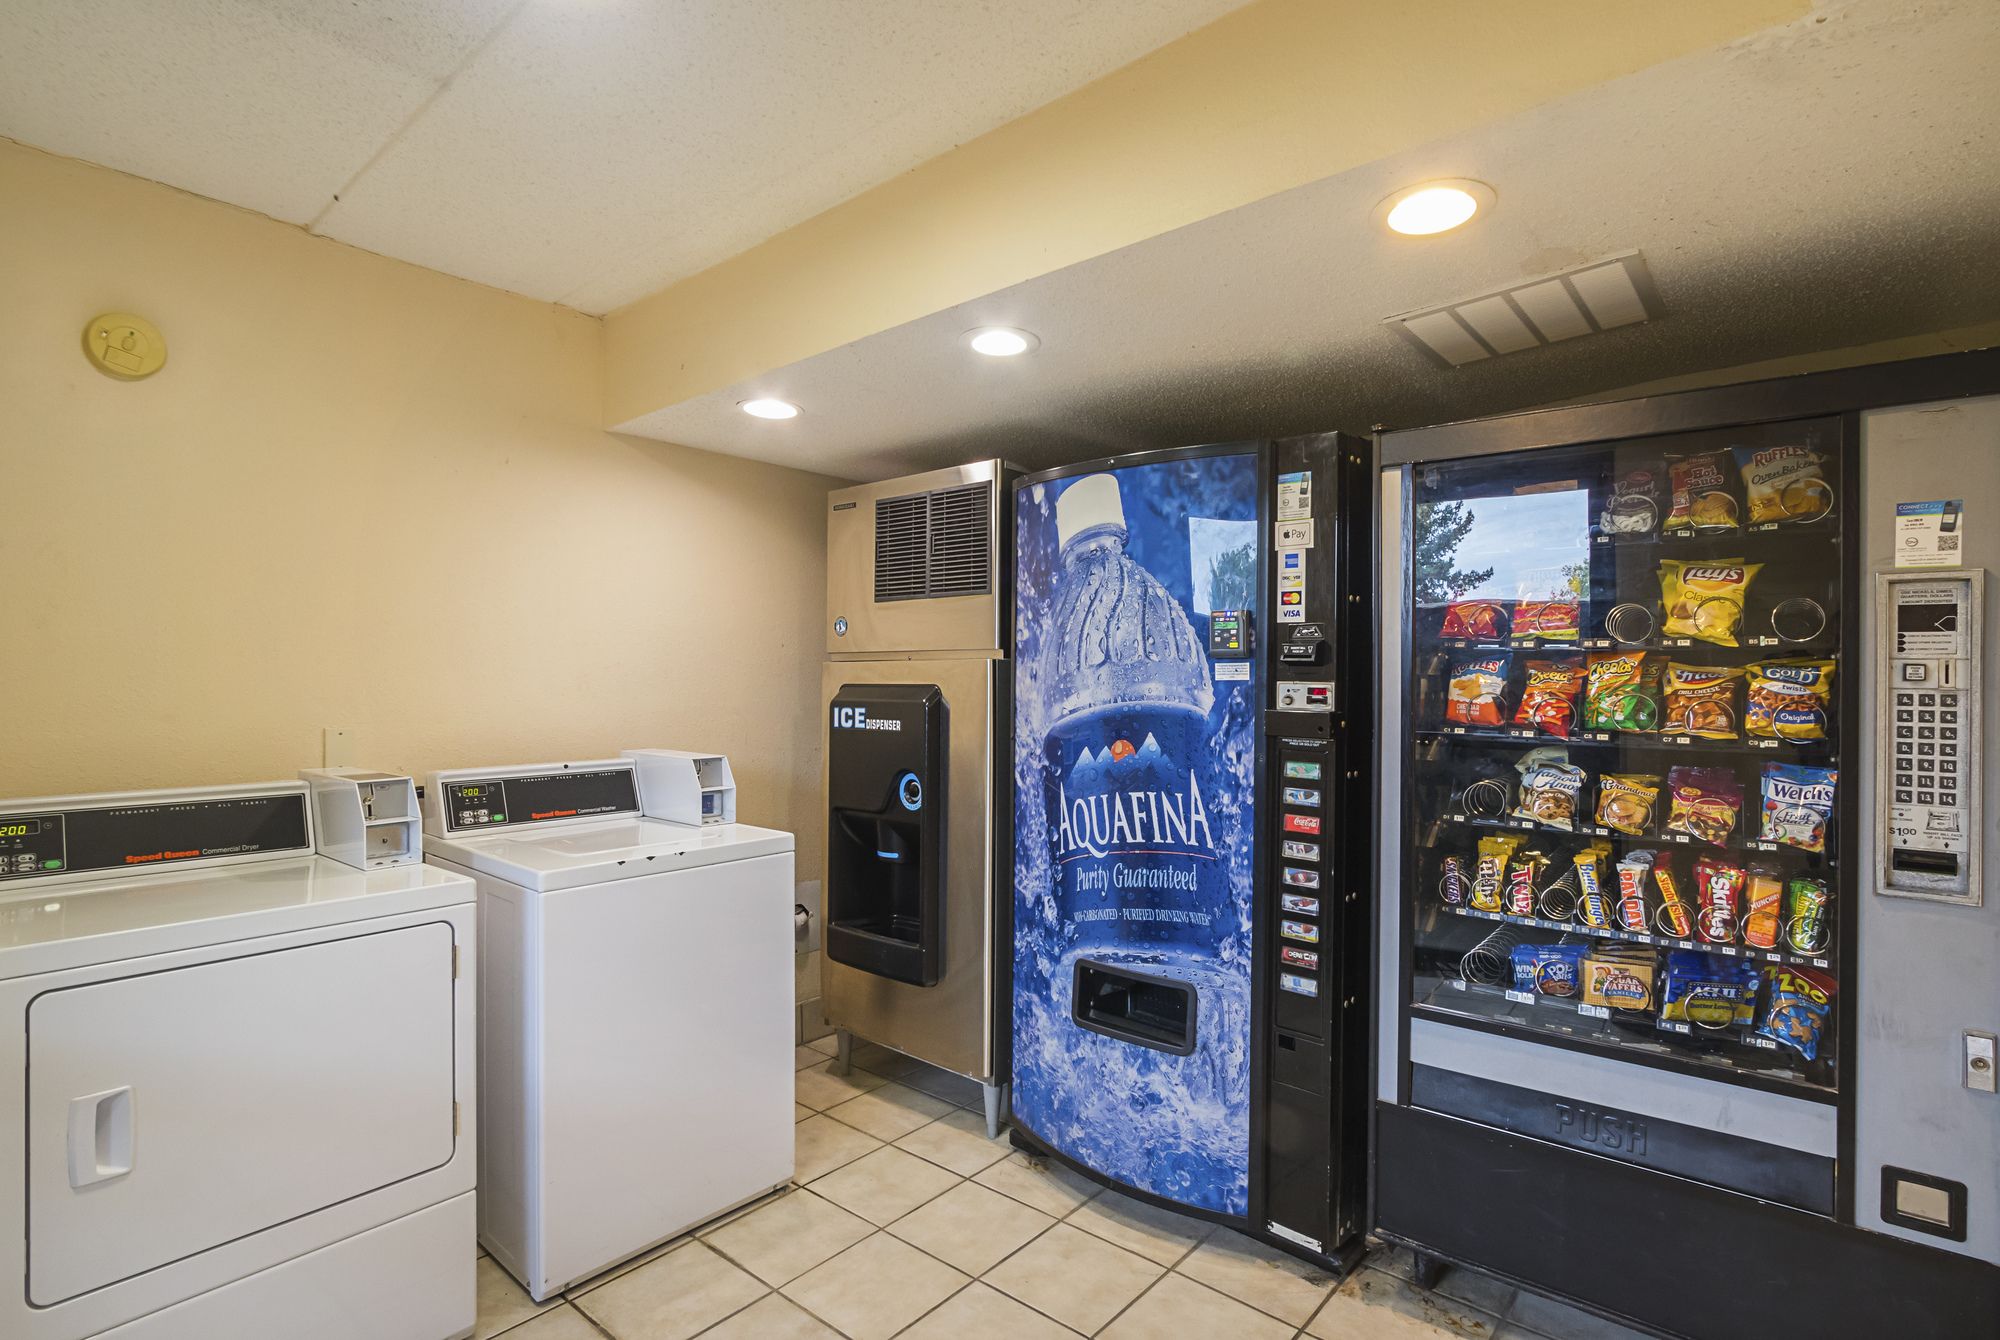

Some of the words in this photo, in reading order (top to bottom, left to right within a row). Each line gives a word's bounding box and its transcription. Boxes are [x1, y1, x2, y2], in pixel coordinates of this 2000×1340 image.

[1754, 446, 1807, 467] RUFFLES
[1291, 529, 1306, 540] Pay
[1284, 610, 1301, 618] VISA
[1588, 656, 1637, 682] Cheetos
[1782, 684, 1807, 692] twists
[834, 707, 866, 729] ICE
[866, 719, 901, 731] DISPENSER
[1536, 779, 1579, 792] Amos
[1773, 783, 1832, 801] Welch's
[578, 806, 601, 814] Commercial
[1060, 768, 1214, 858] AQUAFINA
[126, 852, 162, 863] Speed
[202, 845, 241, 855] Commercial
[242, 843, 259, 851] Dryer
[1077, 864, 1110, 896] Purity
[1113, 863, 1197, 891] Guaranteed
[1512, 866, 1532, 913] TWIX
[1123, 908, 1154, 920] PURIFIED
[1156, 908, 1189, 923] DRINKING
[1709, 876, 1732, 937] Skittles
[1516, 965, 1533, 973] WIN
[1779, 973, 1827, 1004] ZOO
[1555, 1103, 1647, 1156] PUSH
